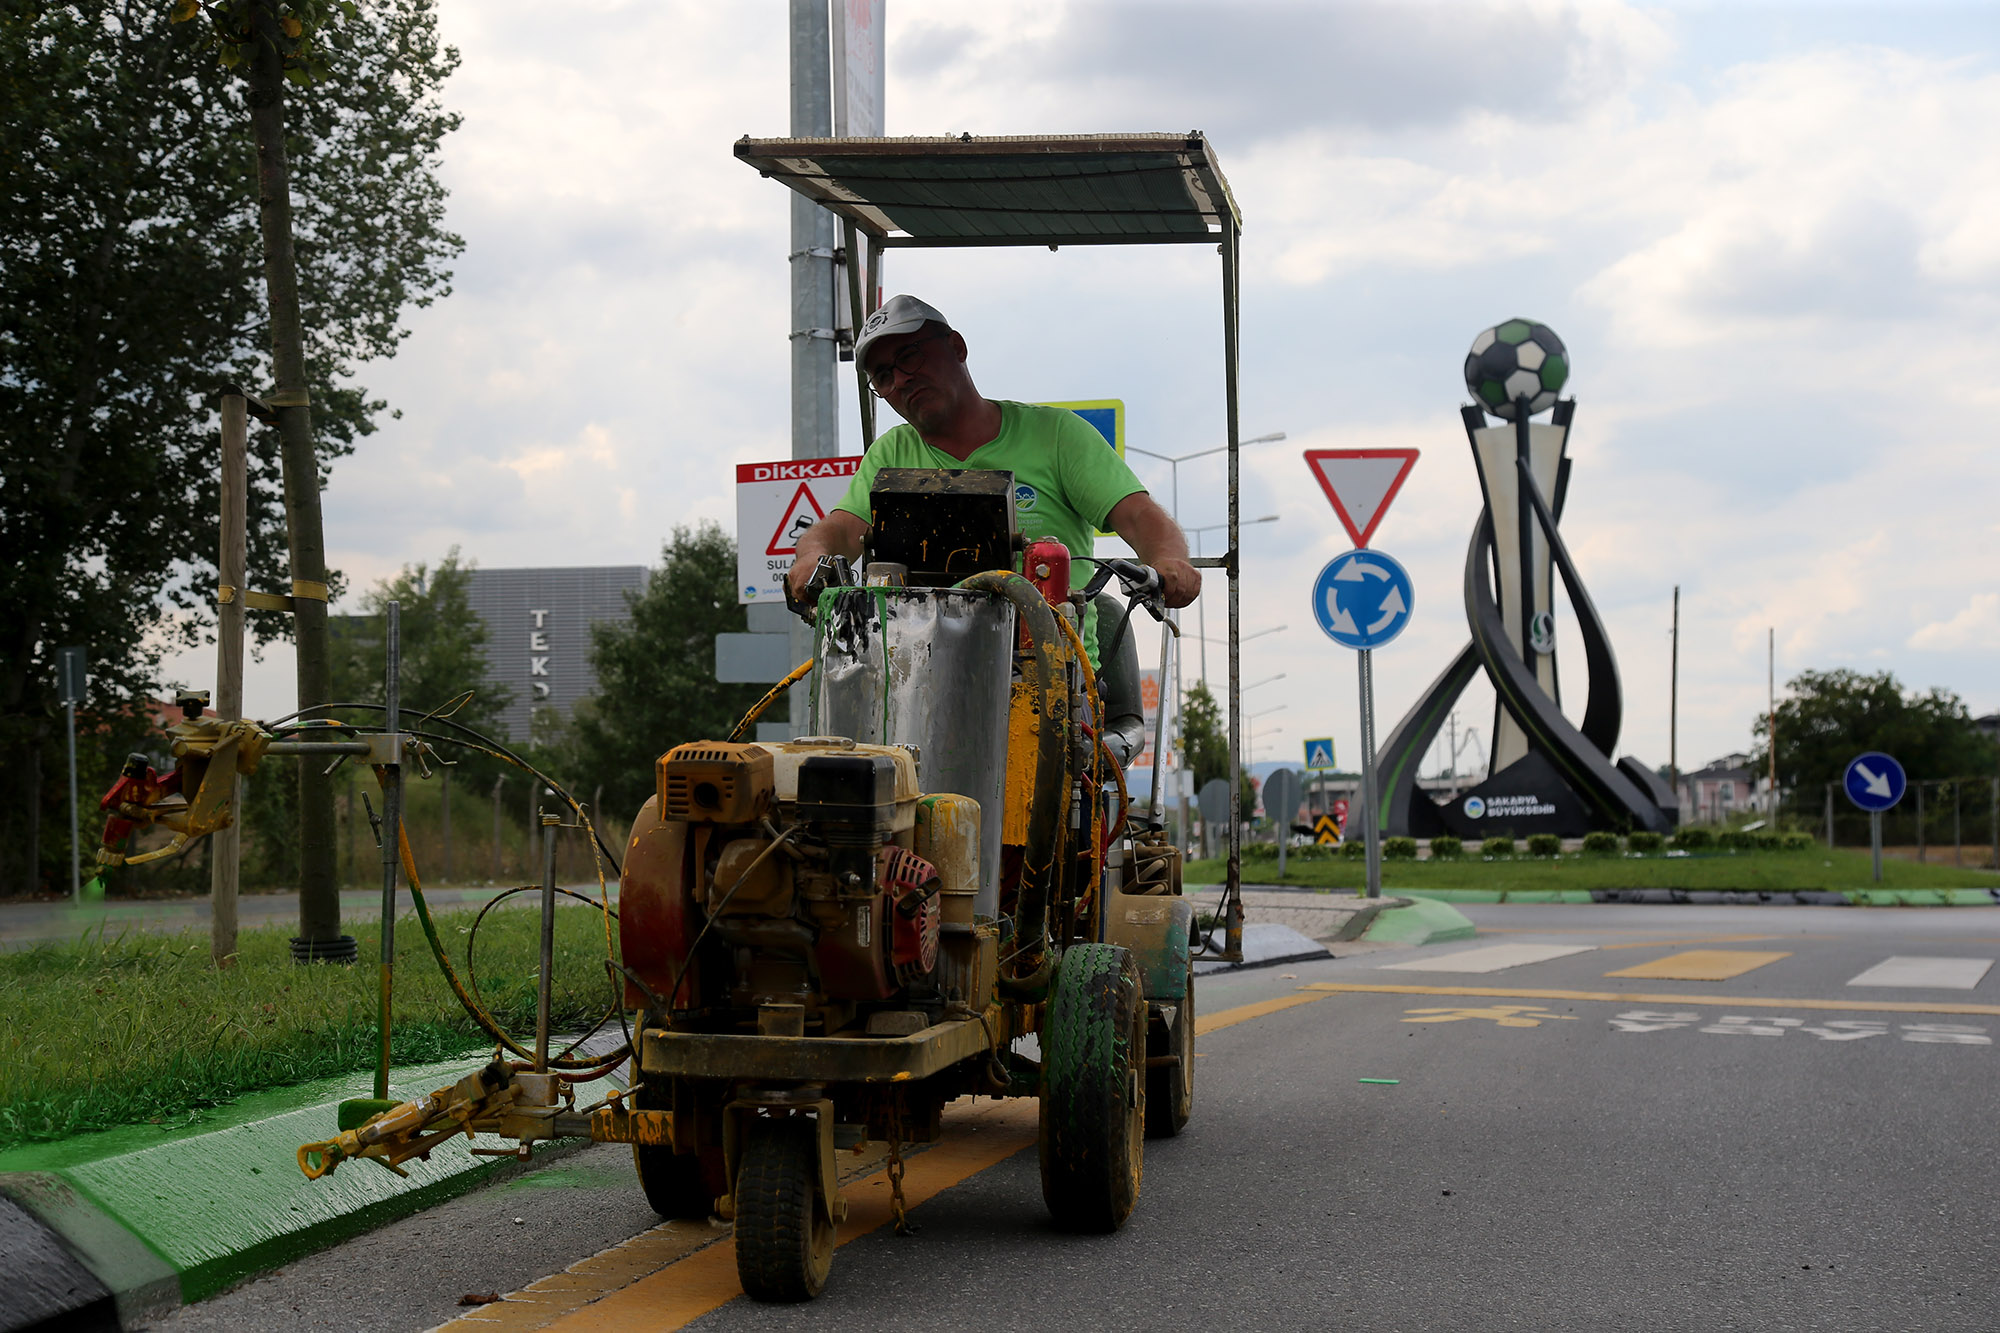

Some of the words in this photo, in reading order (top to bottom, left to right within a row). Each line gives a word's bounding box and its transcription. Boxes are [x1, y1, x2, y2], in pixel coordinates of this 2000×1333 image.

[755, 461, 857, 480] DİKKAT!
[1487, 796, 1538, 806] SAKARYA
[1487, 803, 1556, 817] BÜYÜKŞEHİR
